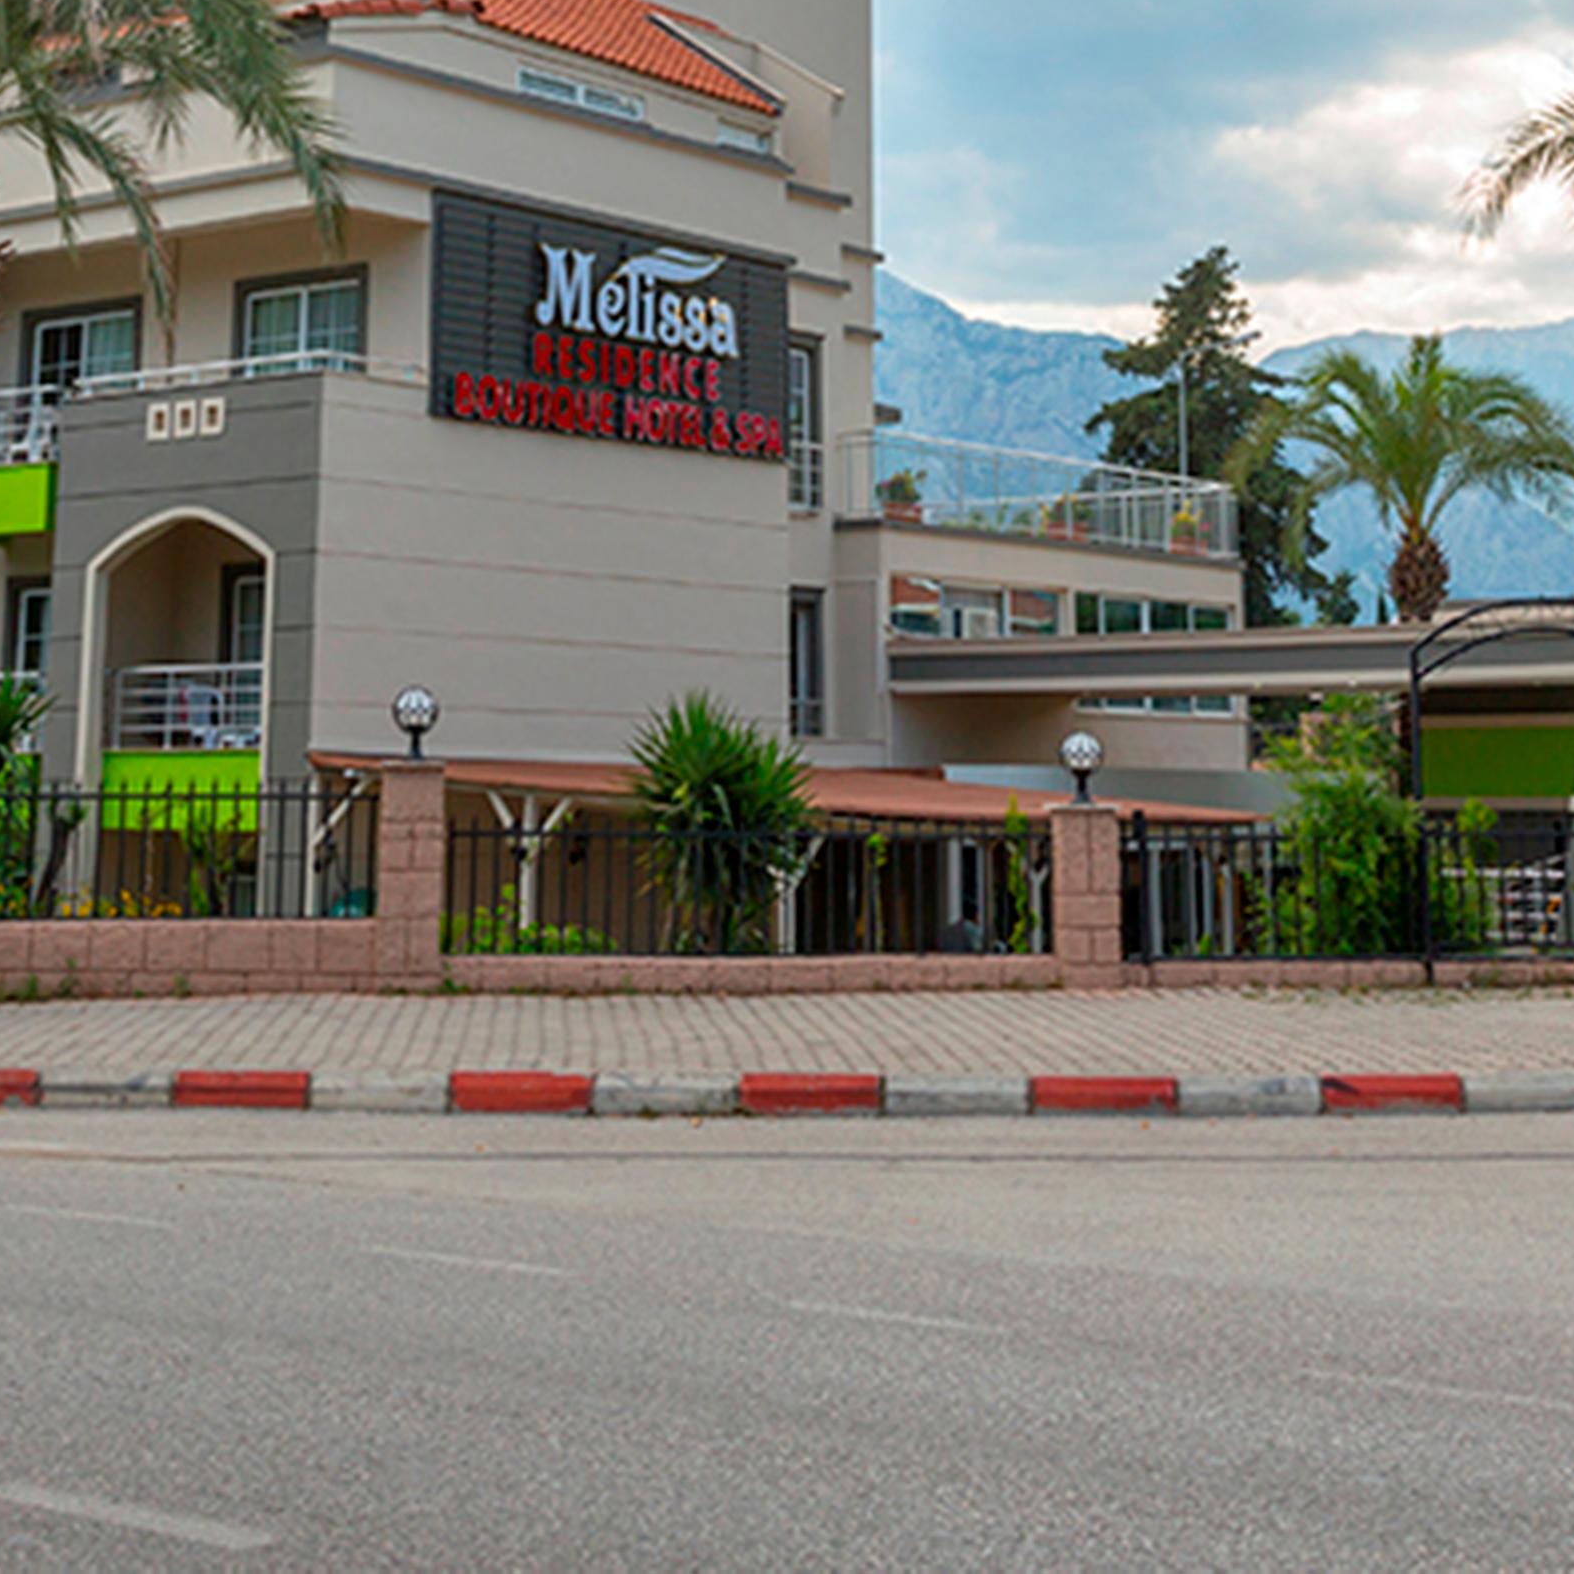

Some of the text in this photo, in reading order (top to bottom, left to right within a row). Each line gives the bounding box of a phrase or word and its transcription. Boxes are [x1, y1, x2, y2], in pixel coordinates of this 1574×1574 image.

[536, 243, 740, 359] Melissa
[532, 332, 722, 402] RESIDENCE
[453, 371, 784, 457] BOUTIQUE HOTEL & SPA
